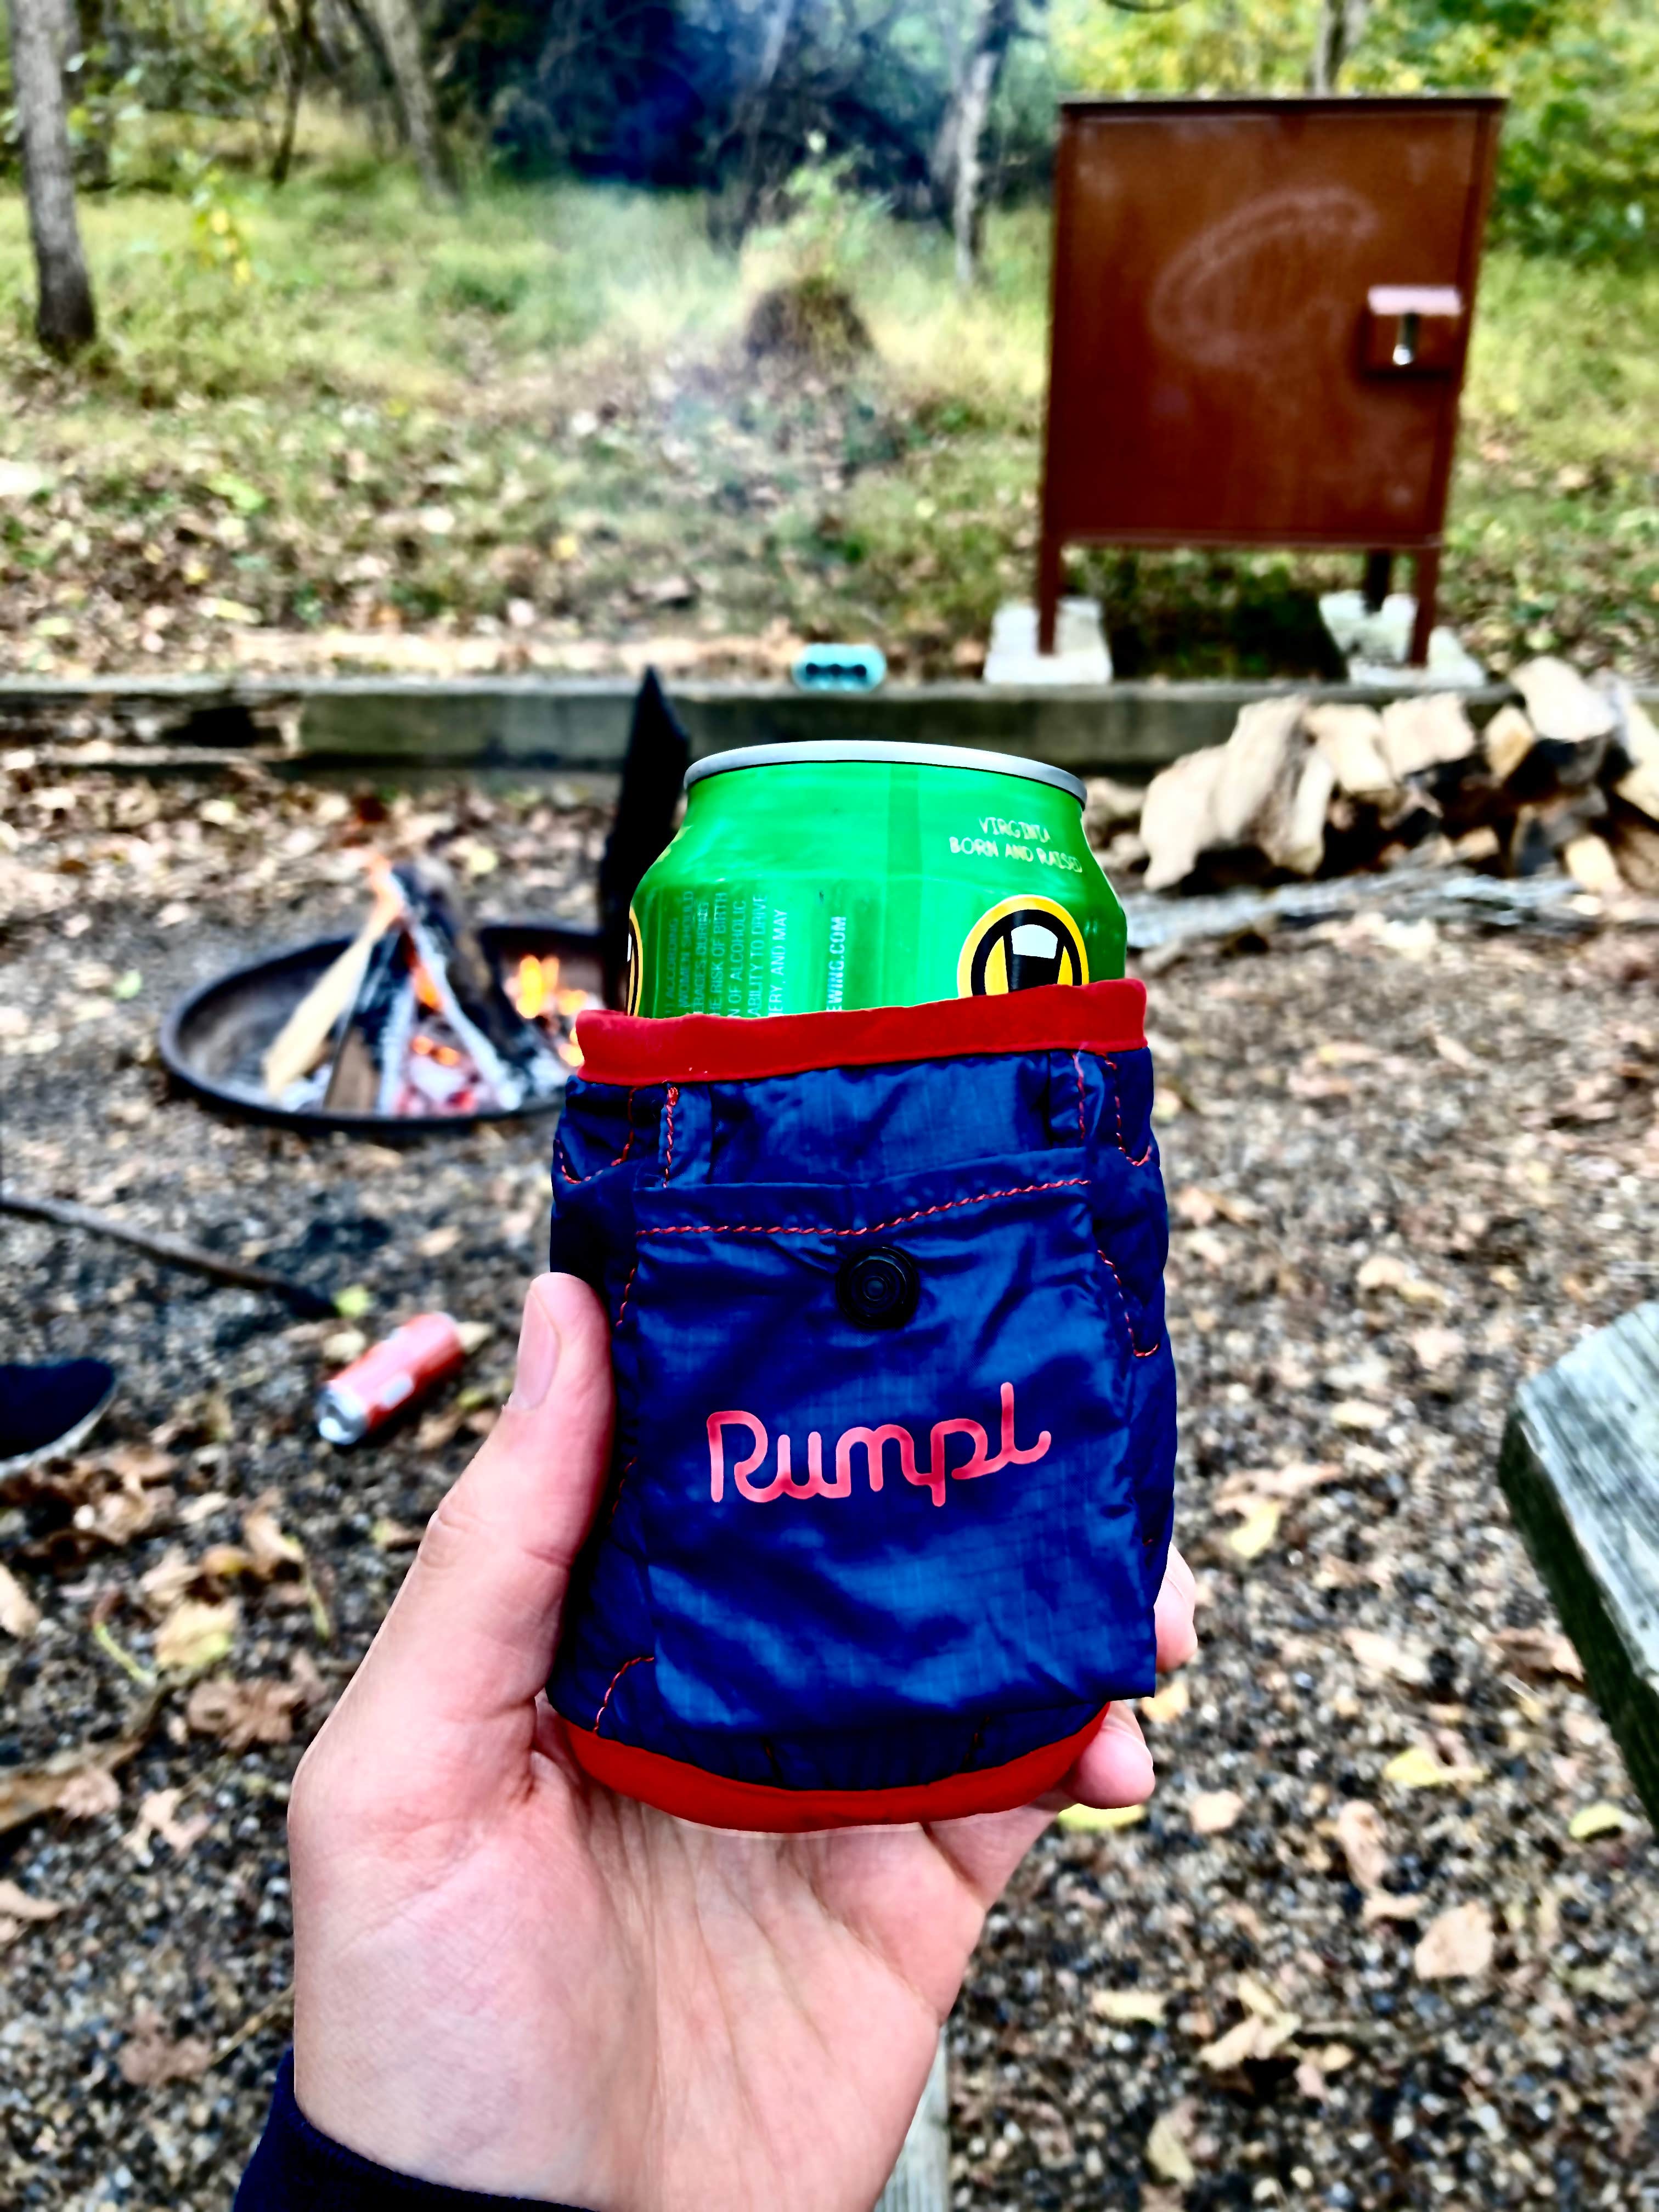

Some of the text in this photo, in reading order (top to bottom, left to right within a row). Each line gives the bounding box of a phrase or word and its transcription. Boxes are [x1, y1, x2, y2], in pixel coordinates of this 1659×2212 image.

[949, 837, 998, 857] BORN
[1005, 843, 1034, 862] AND
[680, 891, 694, 1007] WOMEN SHOULD
[709, 892, 727, 1015] HE RISK OF BIRTH
[731, 900, 747, 981] ALCOHOLIC
[748, 895, 768, 1016] ABILITY TO DRIVE
[771, 945, 786, 975] AND
[773, 909, 788, 940] MAY
[827, 916, 847, 1011] EWING.COM
[694, 960, 707, 1014] ERAGES
[729, 984, 742, 1003] OF
[707, 1382, 1052, 1507] Rumpl
